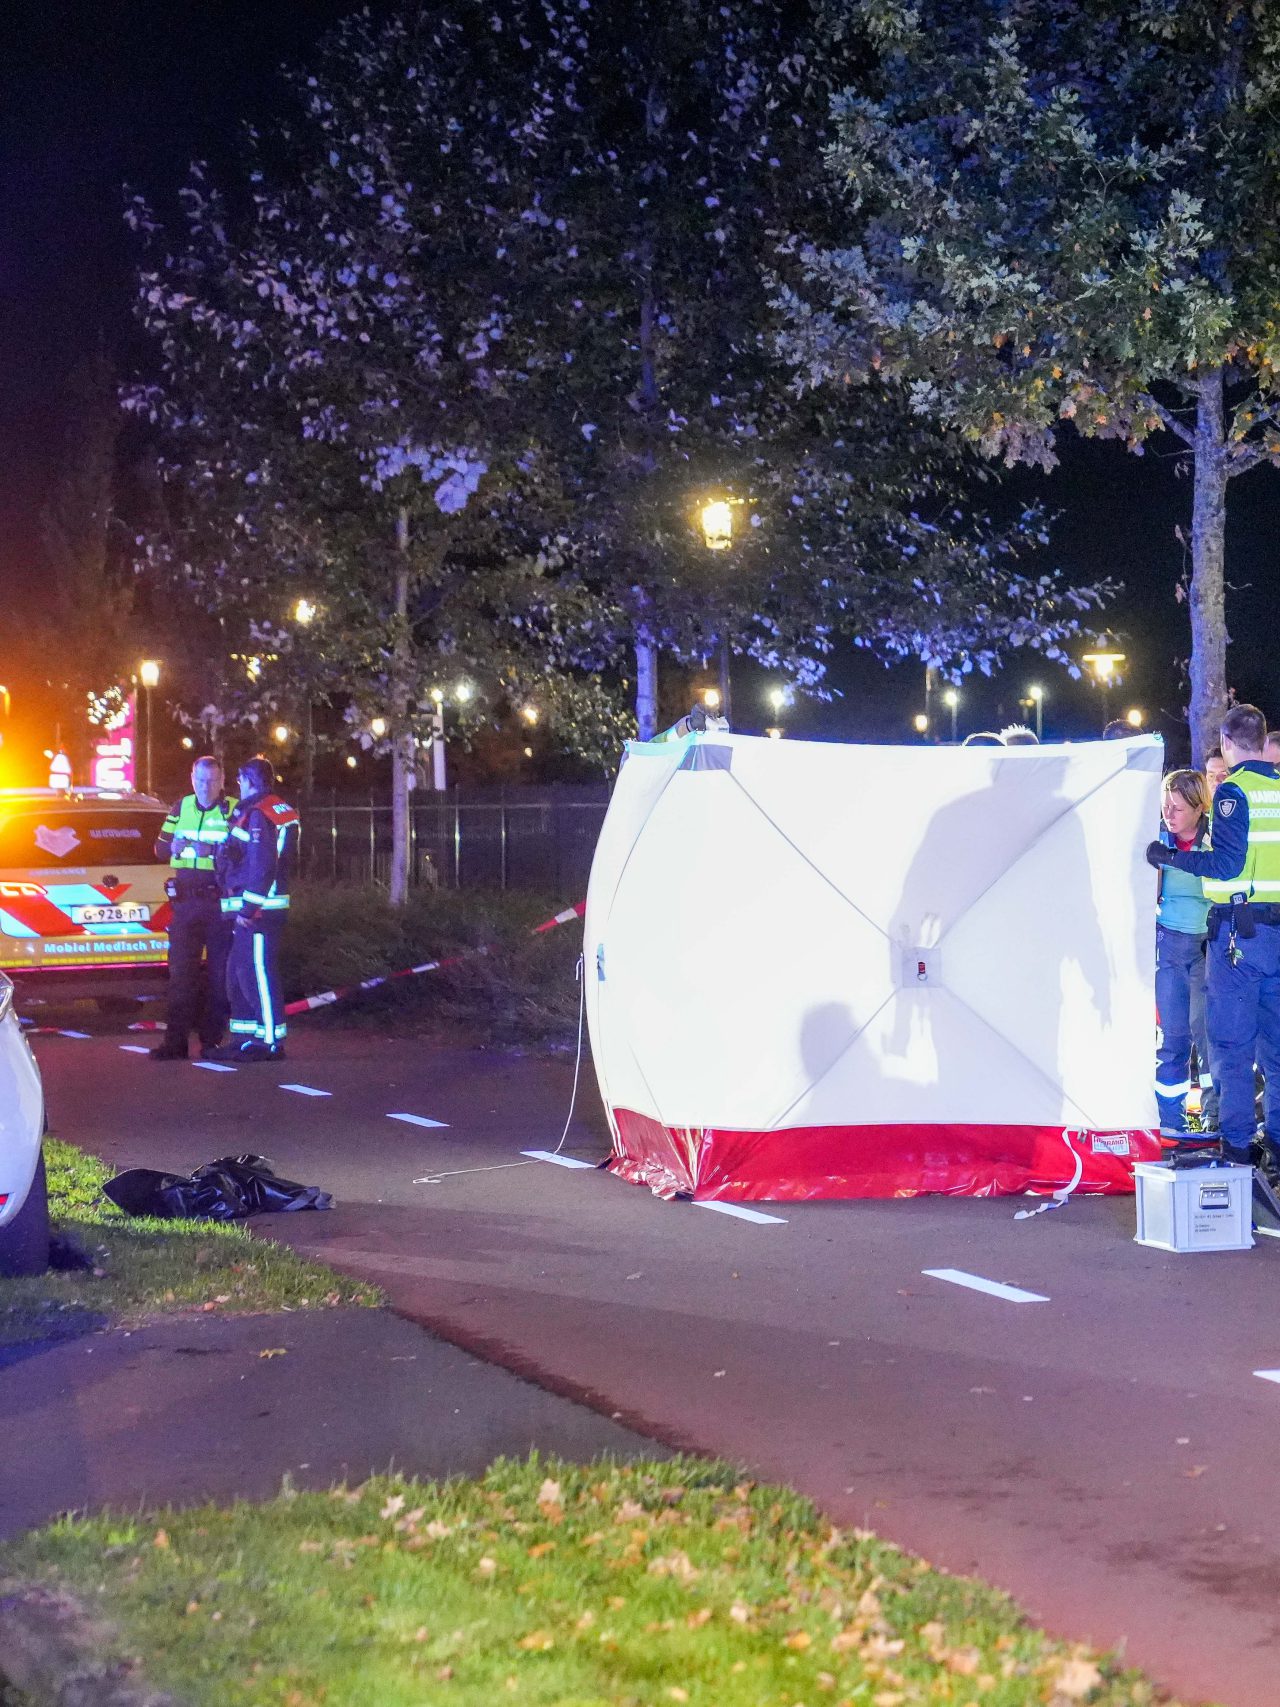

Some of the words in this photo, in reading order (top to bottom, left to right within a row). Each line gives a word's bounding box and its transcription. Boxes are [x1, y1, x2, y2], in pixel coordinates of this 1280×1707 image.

[44, 943, 91, 954] Mobiel
[94, 940, 147, 952] Medisch
[150, 940, 170, 949] Tea
